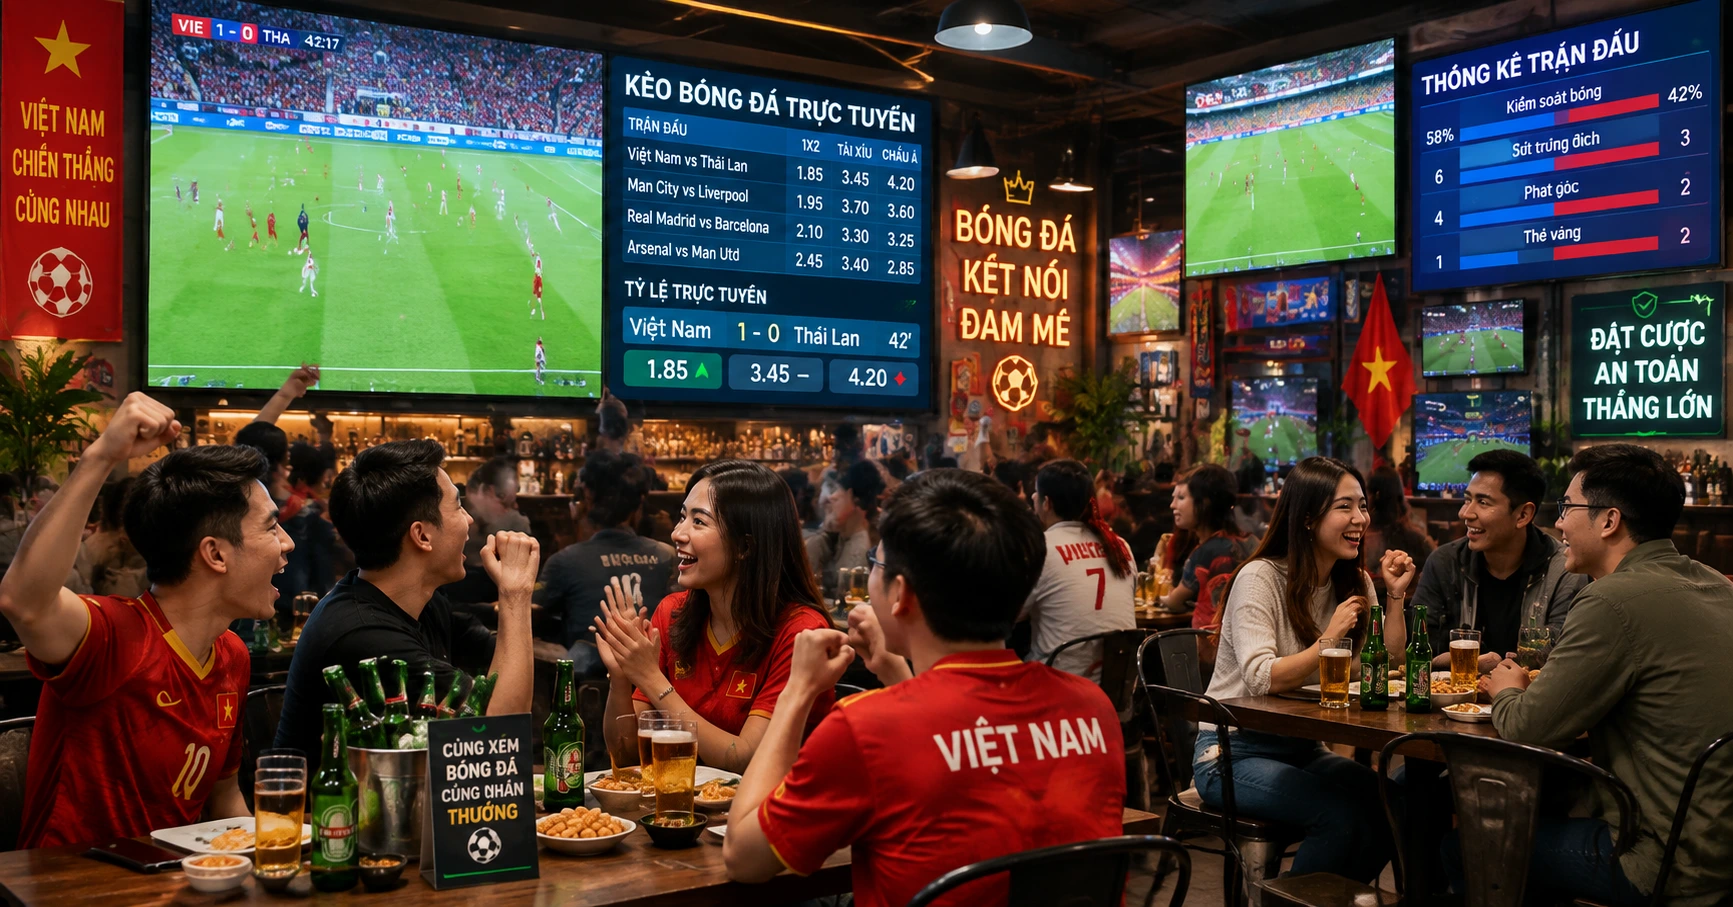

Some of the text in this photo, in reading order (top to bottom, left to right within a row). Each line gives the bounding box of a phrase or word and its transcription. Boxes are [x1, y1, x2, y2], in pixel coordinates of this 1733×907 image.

[178, 18, 204, 35] VIE
[216, 23, 223, 36] 1
[242, 26, 253, 40] 0
[262, 29, 291, 45] THA
[1496, 51, 1523, 81] KÊ
[625, 70, 672, 101] KÈO
[679, 78, 743, 110] BÓNG
[748, 88, 780, 116] ĐÁ
[785, 96, 842, 127] TRỰC
[1667, 84, 1703, 103] 42%
[20, 97, 105, 138] VIỆT NAM
[801, 138, 821, 153] 1X2
[1426, 128, 1454, 145] 58%
[1680, 128, 1691, 147] 3
[655, 149, 681, 165] Nam
[684, 155, 698, 167] vs
[727, 158, 748, 173] Lan
[796, 165, 824, 182] 1.85
[841, 169, 870, 187] 3.45
[887, 175, 915, 192] 4.20
[1434, 168, 1444, 184] 6
[627, 177, 915, 220] Man City vs Liverpool 1.95 3.70 3.60
[1680, 177, 1691, 196] 2
[65, 198, 110, 228] NHAU
[1434, 210, 1444, 226] 4
[627, 208, 915, 248] Real Madrid vs Barcelona 2.10 3.30 3.25
[1039, 214, 1077, 253] ĐÁ
[1680, 227, 1691, 244] 2
[627, 239, 915, 276] Arsenal vs Man Utd 2.45 3.40 2.85
[1436, 255, 1442, 269] 1
[672, 283, 715, 305] TRỰC
[629, 315, 667, 341] Việt
[671, 319, 711, 339] Nam
[738, 322, 745, 341] 1
[767, 323, 780, 343] 0
[831, 328, 860, 347] Lan
[960, 307, 1023, 343] ĐAM
[647, 359, 689, 380] 1.85
[750, 363, 790, 384] 3.45
[848, 367, 888, 388] 4.20
[1593, 360, 1628, 385] AN
[1666, 388, 1713, 419] LỚN
[1085, 567, 1106, 610] 7
[932, 715, 1108, 775] VIỆT NAM
[171, 742, 211, 800] 10
[446, 756, 519, 781] BÓNG ĐÁ
